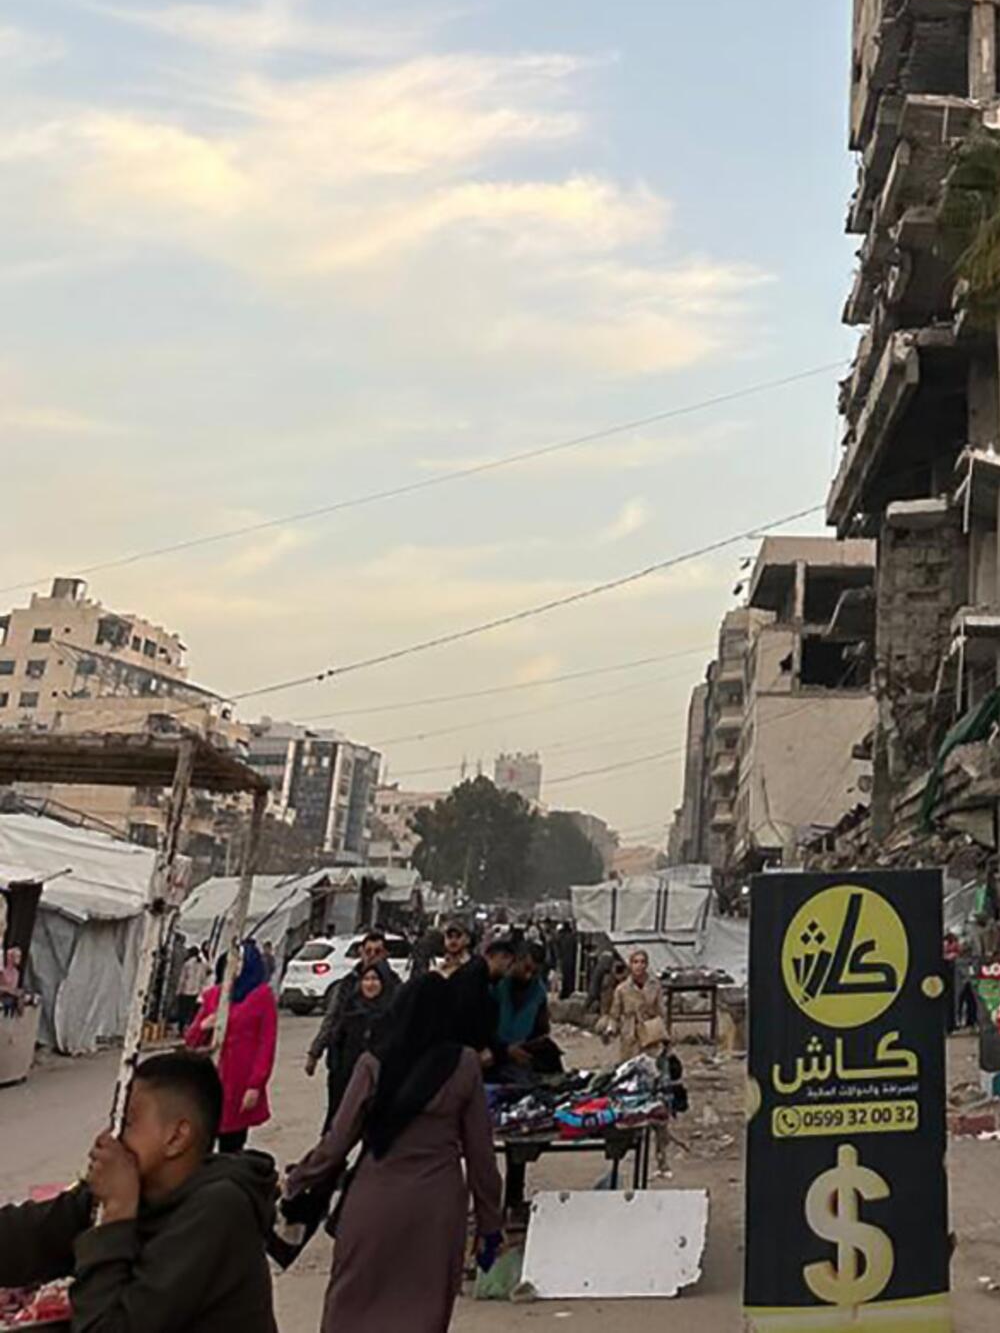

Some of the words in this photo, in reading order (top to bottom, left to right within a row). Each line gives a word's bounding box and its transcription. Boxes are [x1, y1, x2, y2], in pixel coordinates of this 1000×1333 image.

[771, 1030, 919, 1095] كاش
[803, 1111, 844, 1127] 0599
[849, 1110, 867, 1126] 32
[870, 1108, 892, 1124] 00
[895, 1105, 915, 1122] 32
